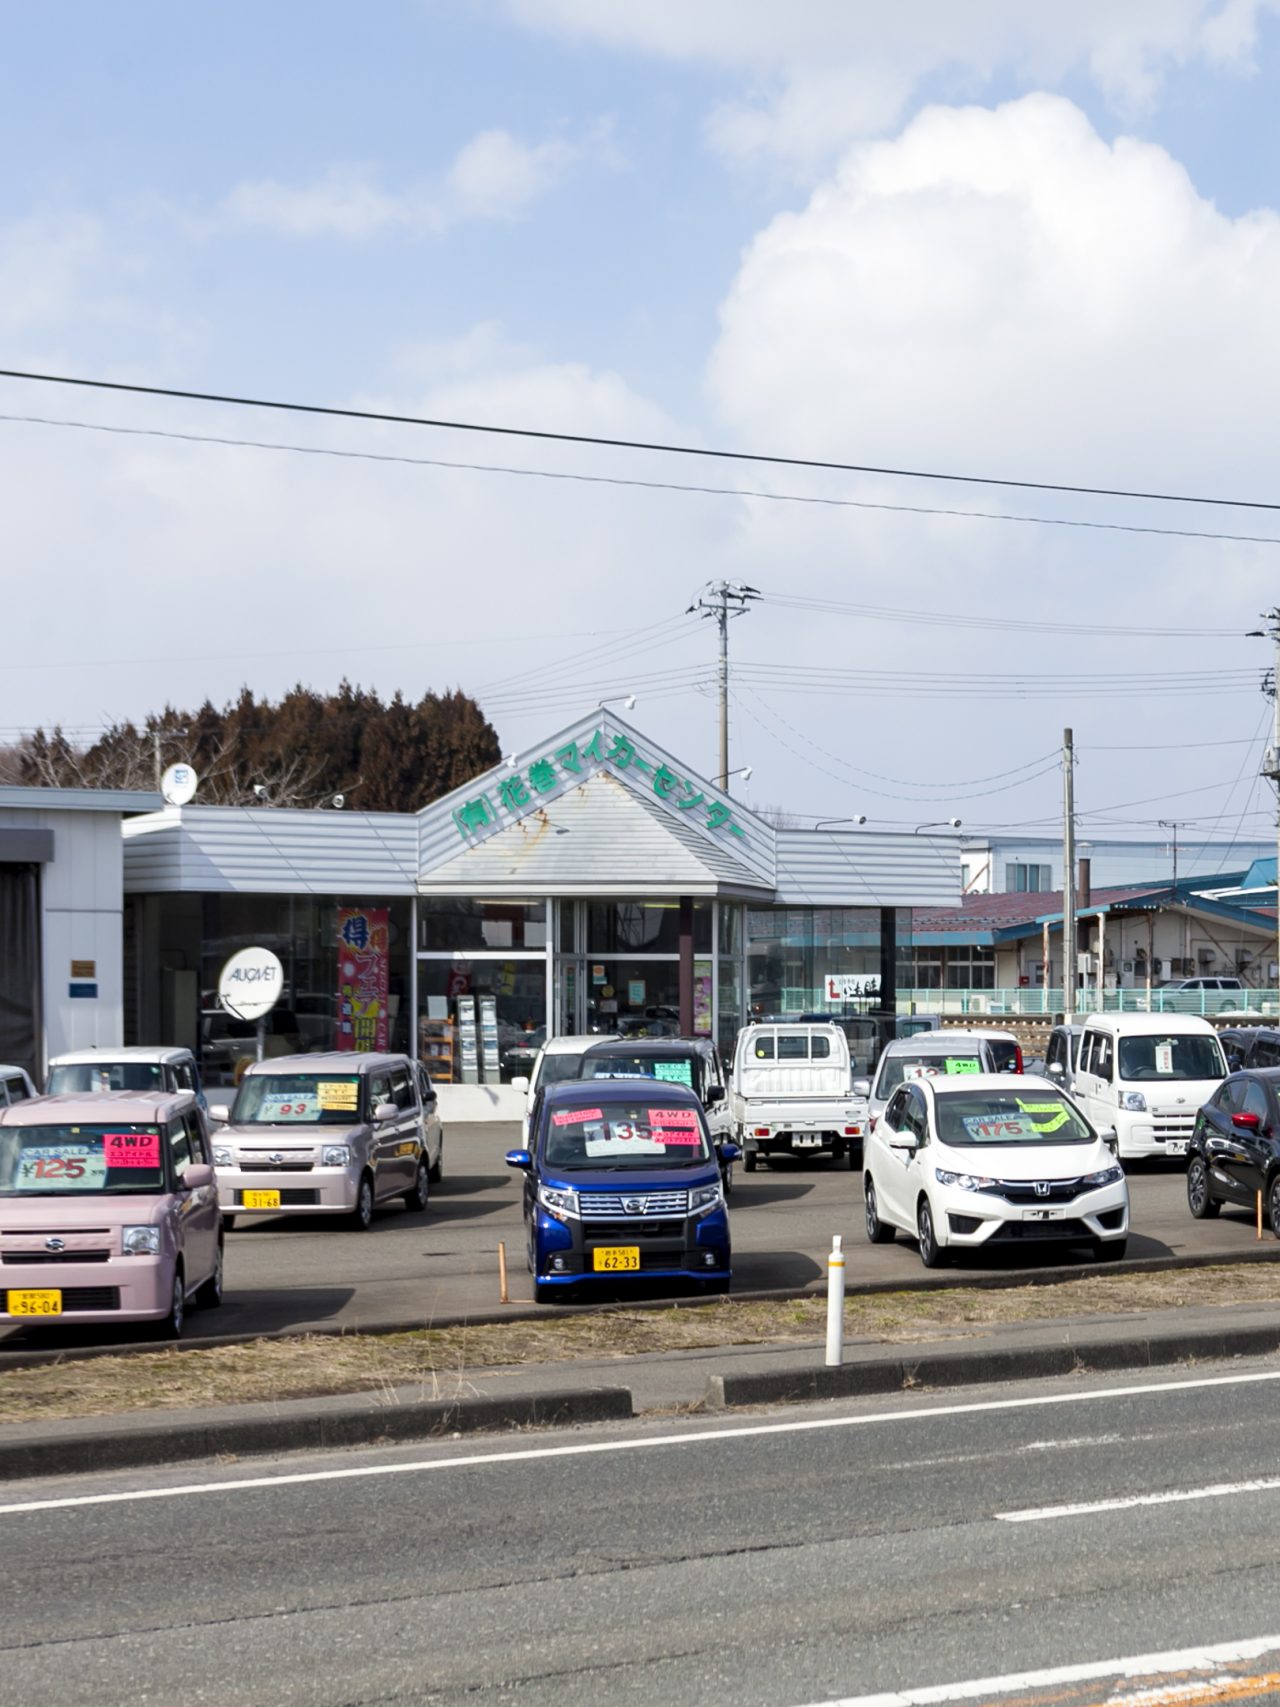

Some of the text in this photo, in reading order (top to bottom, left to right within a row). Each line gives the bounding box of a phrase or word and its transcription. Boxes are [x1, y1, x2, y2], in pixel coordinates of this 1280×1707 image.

[279, 1104, 306, 1115] 93
[110, 1136, 153, 1148] 4WD
[604, 1256, 637, 1269] 62-33
[20, 1300, 59, 1314] 96-04
